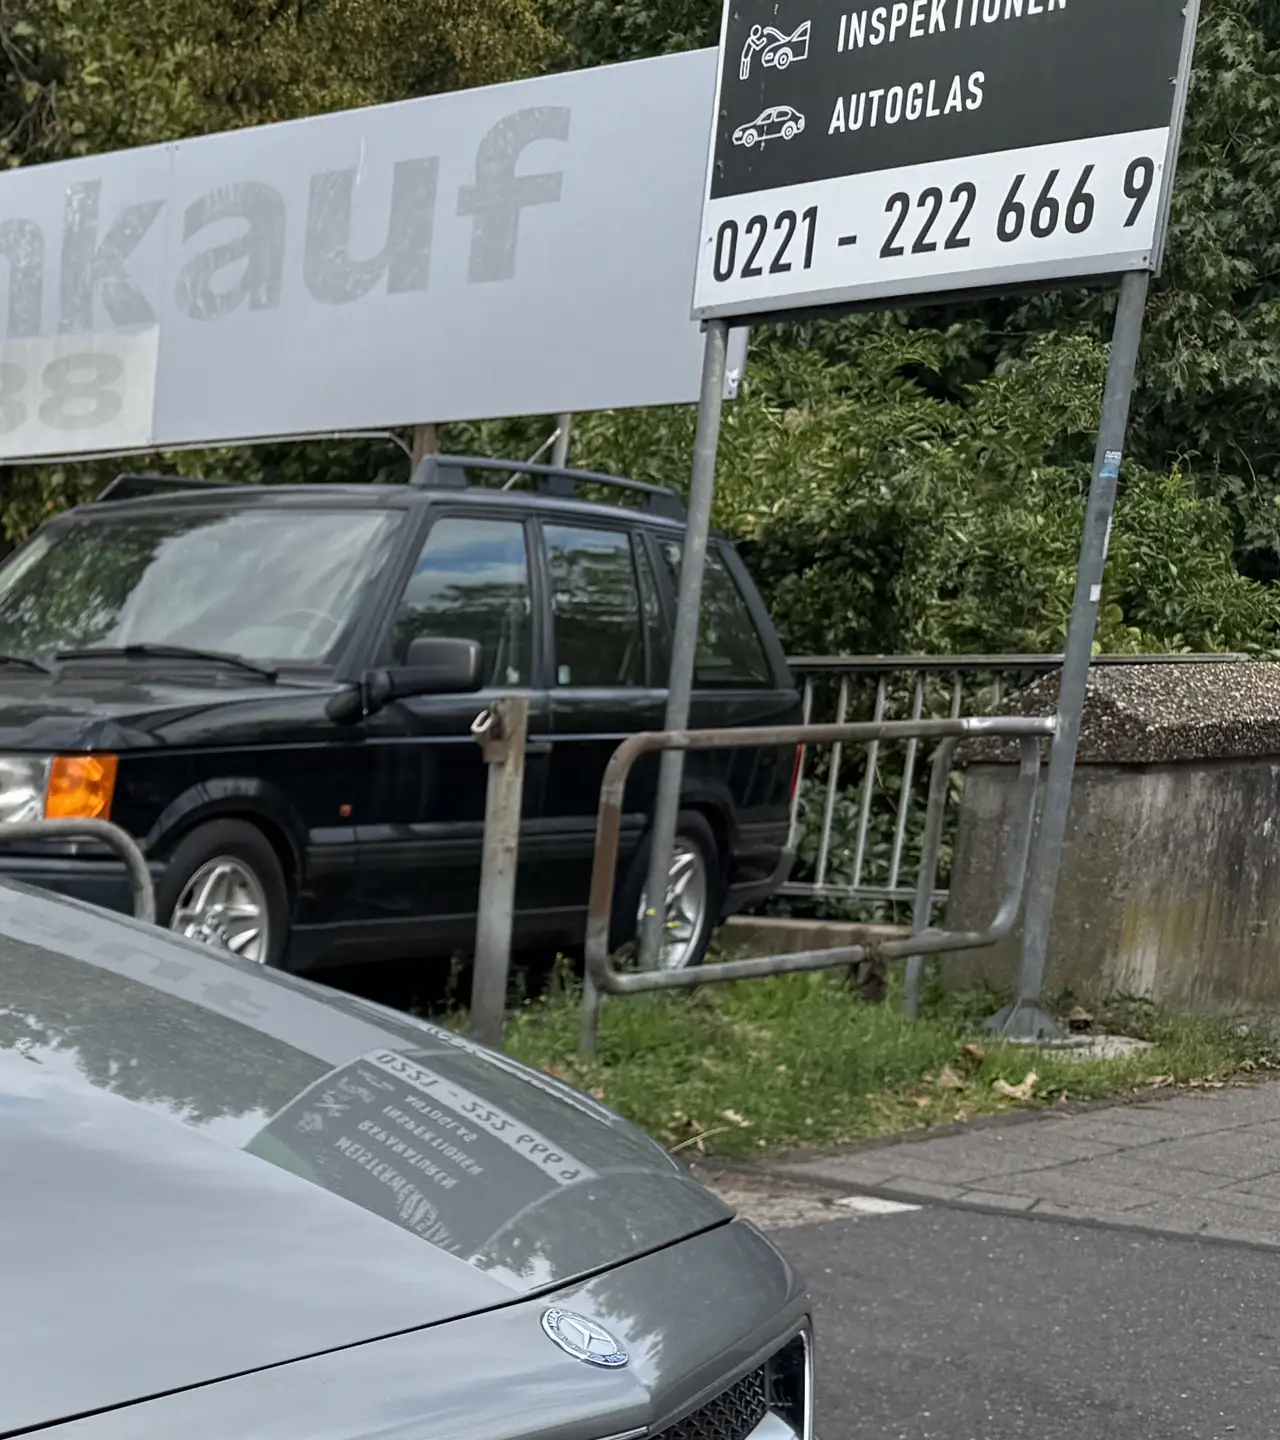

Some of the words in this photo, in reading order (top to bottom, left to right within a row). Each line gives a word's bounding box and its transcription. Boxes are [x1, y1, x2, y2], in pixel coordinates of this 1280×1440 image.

[837, 0, 1067, 52] INSPEKTION
[828, 71, 986, 135] AUTOGLAS
[712, 205, 818, 282] 0221
[837, 234, 857, 247] -
[879, 181, 977, 259] 222
[996, 164, 1095, 243] 666
[1122, 156, 1154, 228] 9
